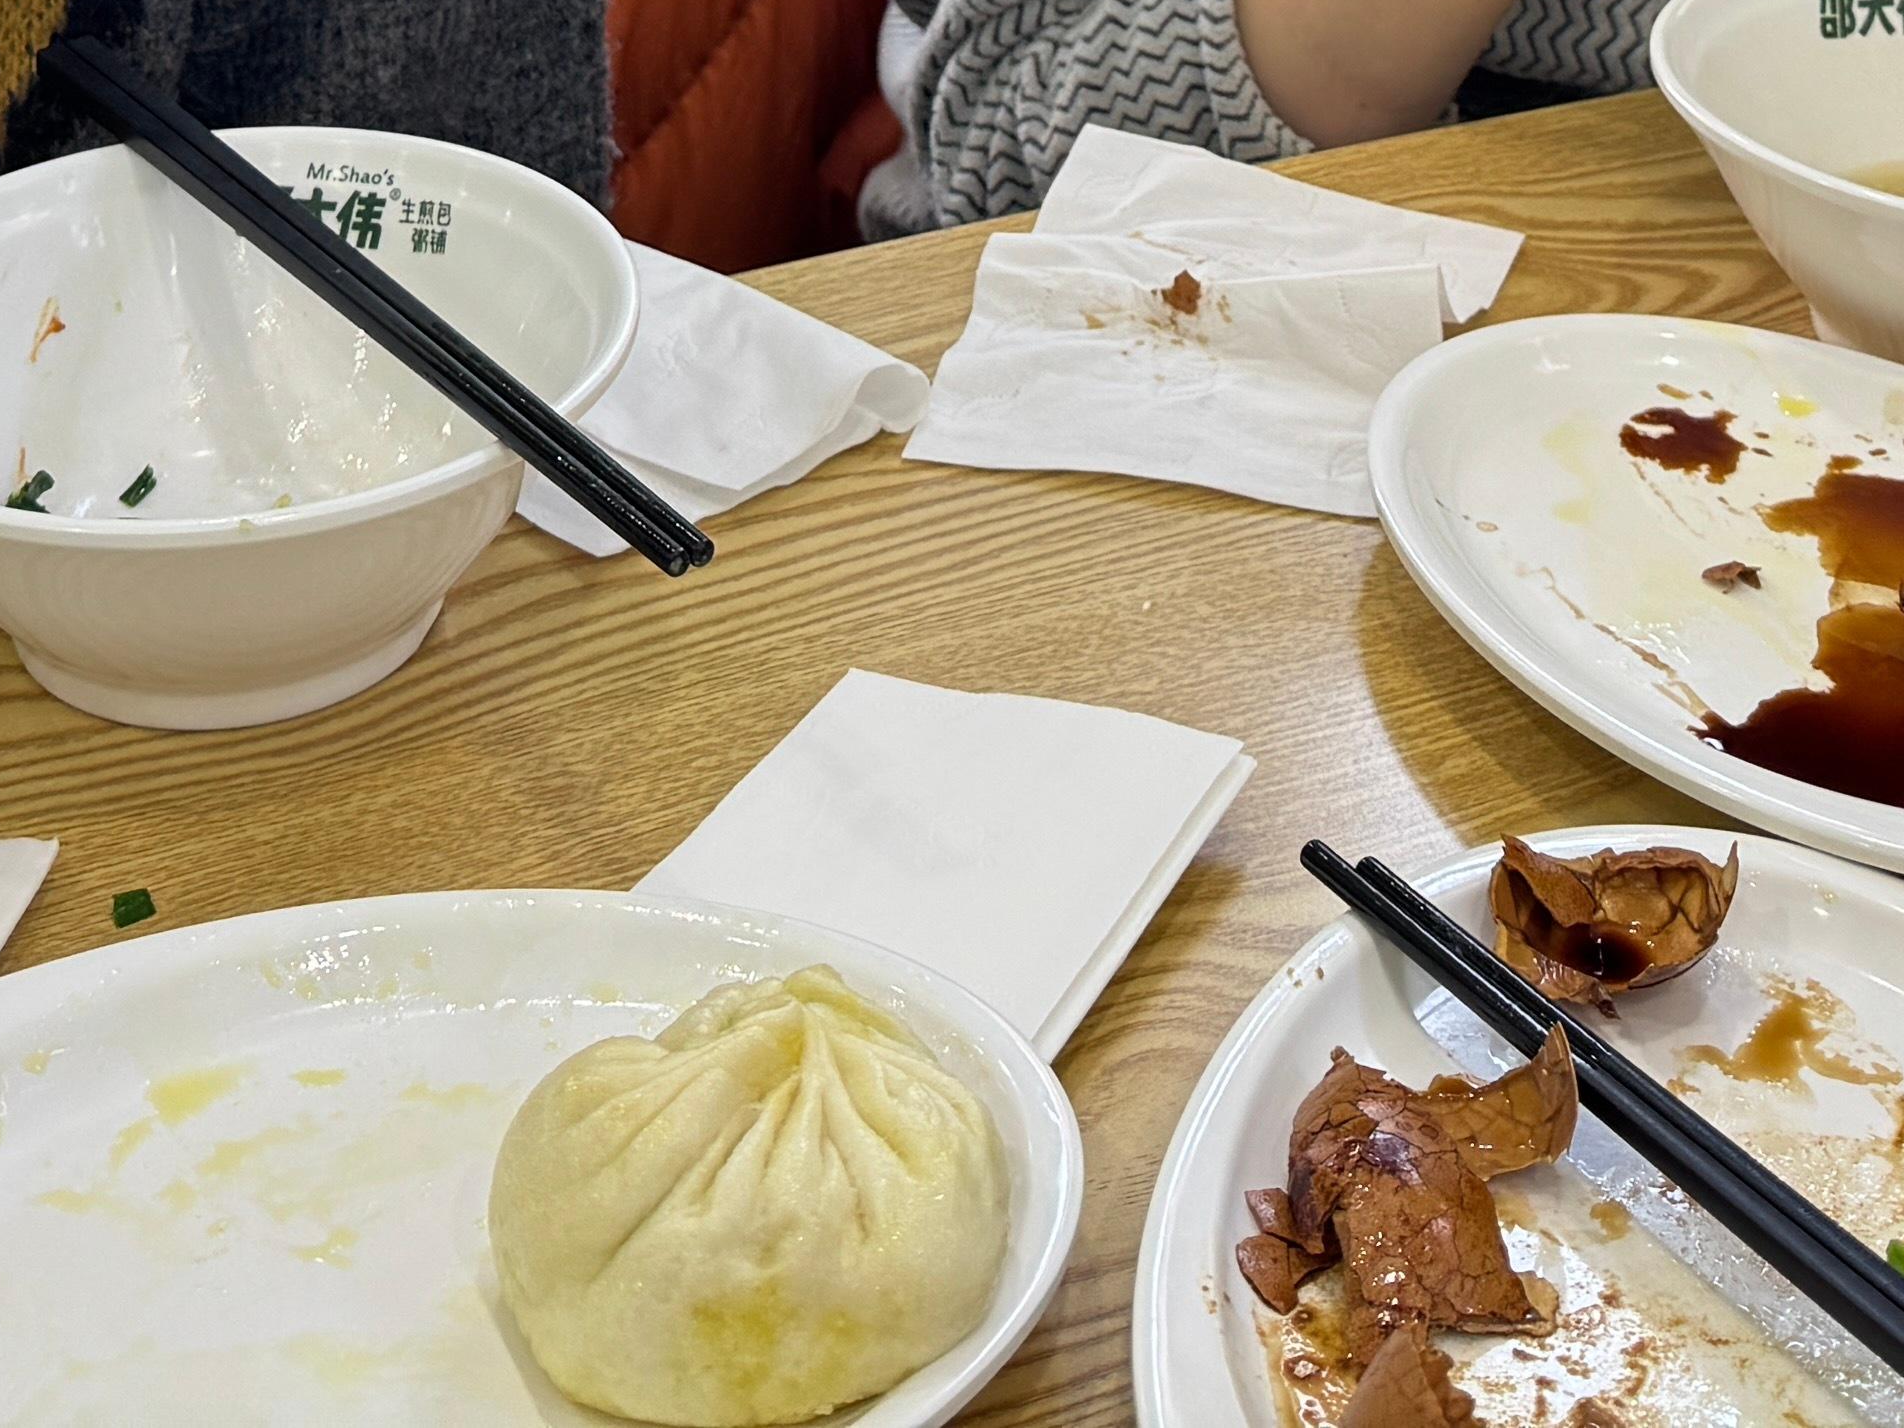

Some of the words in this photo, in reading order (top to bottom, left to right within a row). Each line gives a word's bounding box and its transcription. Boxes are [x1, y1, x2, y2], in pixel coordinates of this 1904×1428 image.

[306, 162, 394, 185] Mr.Shao's
[398, 198, 452, 227] 生煎包
[411, 227, 447, 255] 粥铺
